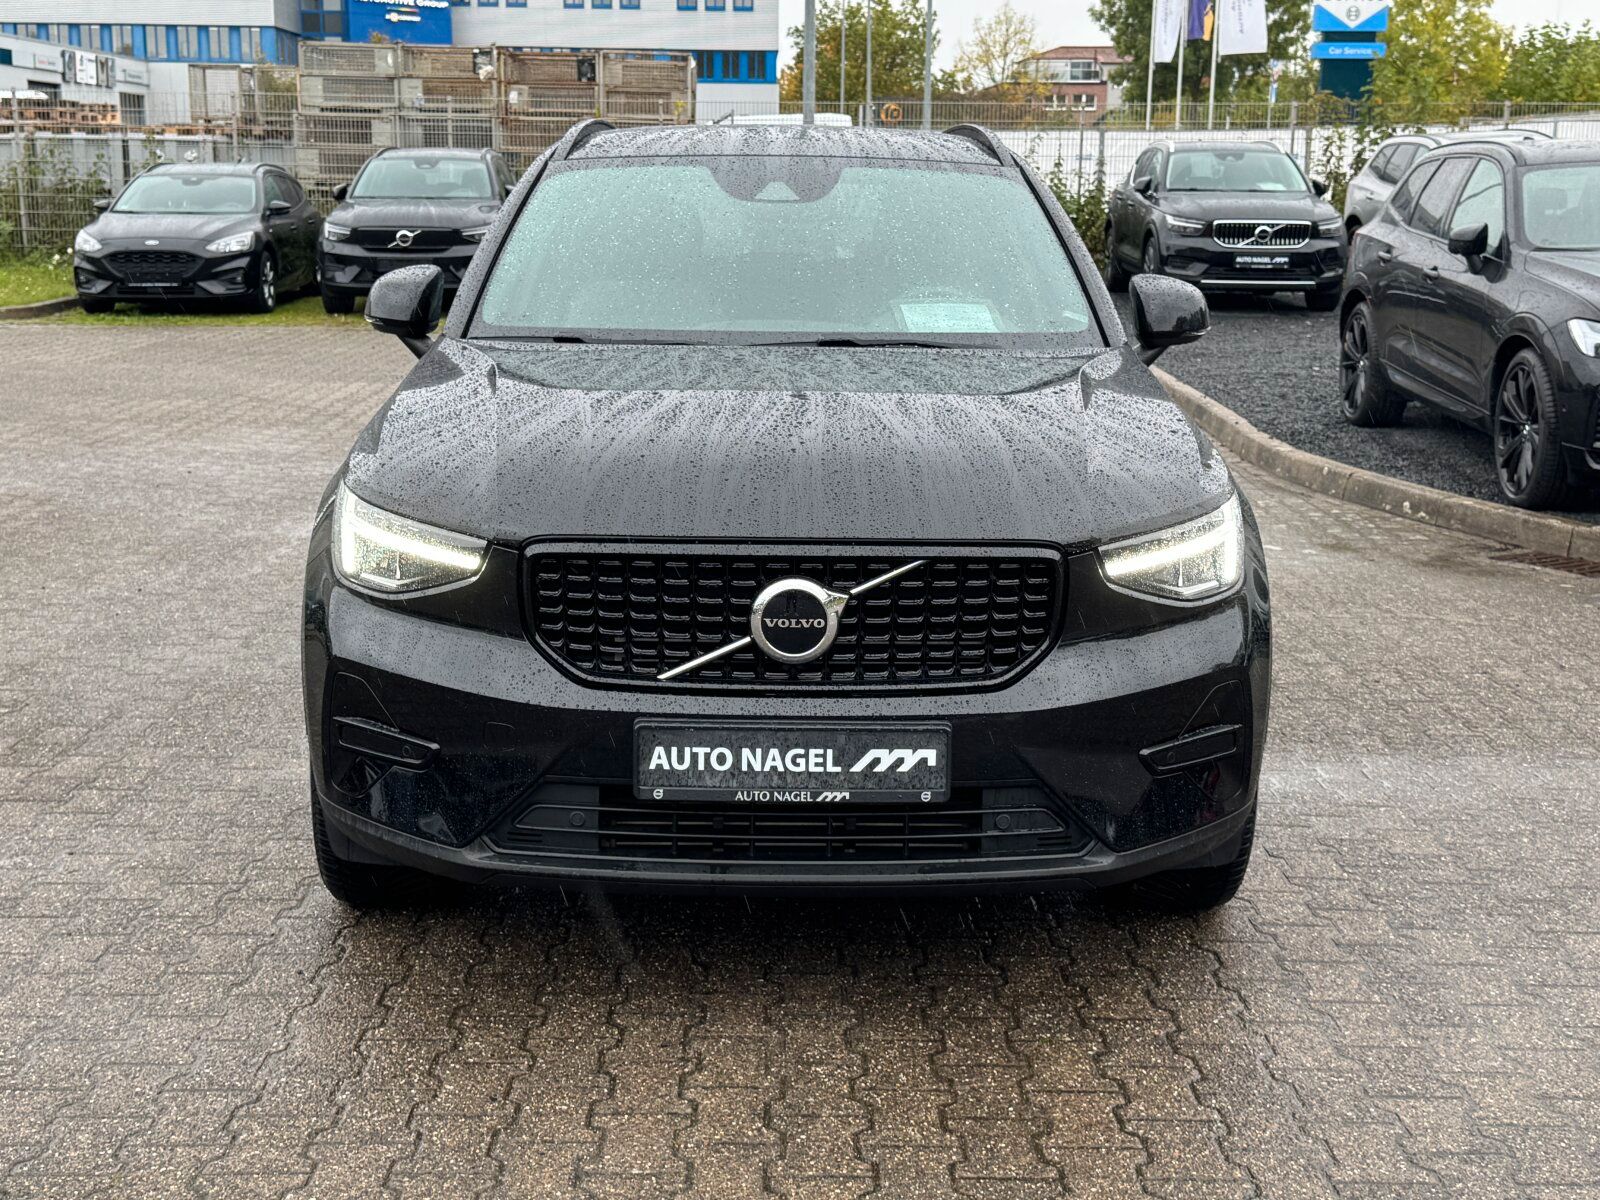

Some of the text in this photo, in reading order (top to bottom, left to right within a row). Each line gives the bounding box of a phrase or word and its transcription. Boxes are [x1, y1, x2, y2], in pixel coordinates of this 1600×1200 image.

[1328, 46, 1342, 55] Car
[763, 618, 826, 628] VOLVO
[648, 746, 842, 773] AUTO NAGEL
[735, 791, 813, 802] AUTO NAGEL
